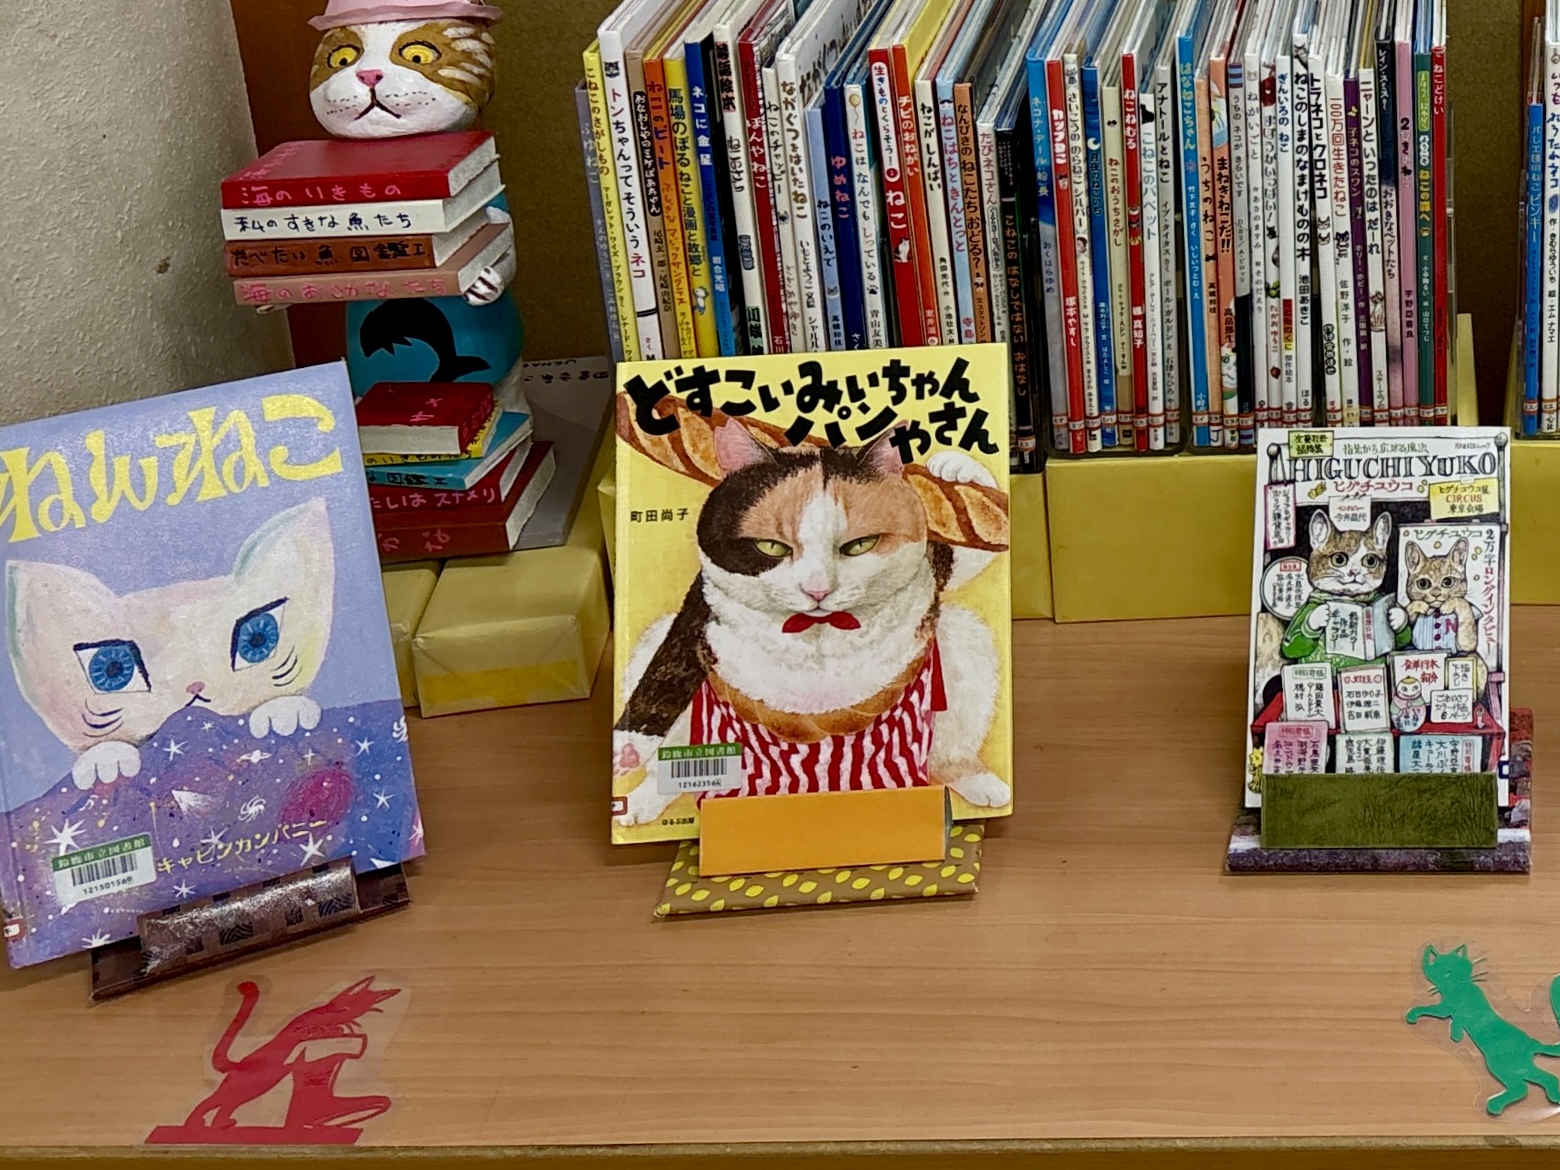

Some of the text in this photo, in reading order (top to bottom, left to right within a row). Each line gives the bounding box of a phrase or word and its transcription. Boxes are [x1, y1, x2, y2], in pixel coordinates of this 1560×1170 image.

[585, 66, 611, 176] こねこのさがしもの
[647, 80, 670, 170] ねこのピート
[668, 87, 690, 167] 馬場のぼる
[691, 85, 714, 166] ネコに金星
[1123, 89, 1138, 150] ねこねむる
[1180, 63, 1196, 150] はなねこちゃん
[1247, 92, 1260, 160] ねがいごと
[1277, 73, 1290, 153] ぎんいろの ねこ
[1433, 64, 1445, 115] ねこどけい
[781, 80, 808, 219] ながぐつをはいたねこ
[897, 95, 919, 177] チビのおねがい
[979, 132, 997, 205] たびネコさん
[1157, 82, 1171, 184] アナトールとねこ
[1294, 73, 1311, 262] ねこのしまのなまけものの木
[1310, 73, 1328, 200] トラネコとクロネコ
[1348, 127, 1362, 198] 子ネコのスワン
[610, 89, 646, 278] トンちゃんってそういうネコ
[830, 156, 850, 219] ゆめねこ
[886, 189, 908, 230] ねこ
[940, 114, 966, 252] ねこはちときんとっと
[1108, 158, 1124, 247] ねこのおうちさがし
[1200, 157, 1215, 243] うちのねこ
[677, 170, 703, 277] ねこと漫画と故郷と
[711, 256, 726, 292] 岩合光昭
[1298, 274, 1310, 325] 池田あきこ
[1339, 280, 1350, 323] 佐野洋子
[870, 309, 883, 348] 青山友美
[623, 357, 982, 438] どすこいみいちゃん
[785, 401, 1000, 464] パンやさん
[0, 393, 343, 544] ねんねこ
[1287, 454, 1496, 482] HIGUCHI YUKO
[1333, 479, 1414, 493] ヒグチユウコ
[1446, 494, 1482, 503] CIRCUS
[629, 507, 690, 524] 町田尚子
[157, 820, 328, 874] キャビンカンパニー
[662, 817, 695, 825] ほるぷ出版
